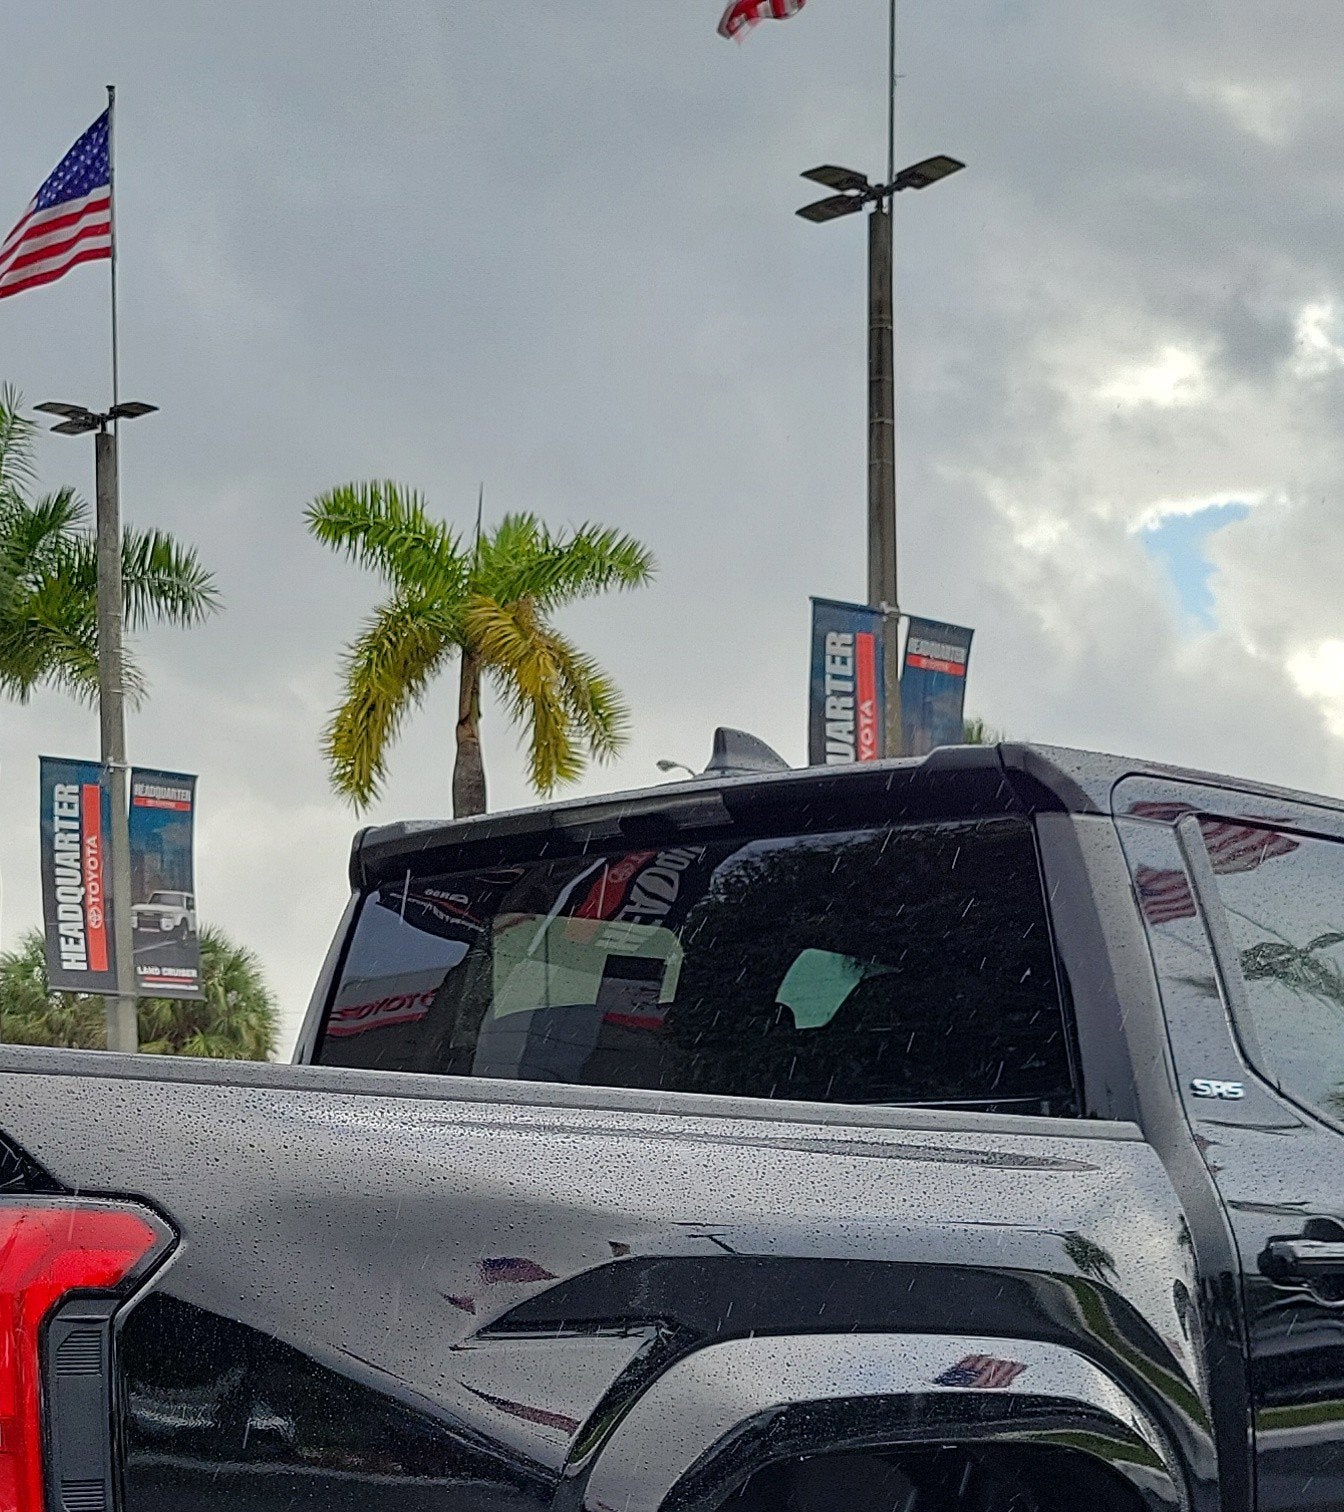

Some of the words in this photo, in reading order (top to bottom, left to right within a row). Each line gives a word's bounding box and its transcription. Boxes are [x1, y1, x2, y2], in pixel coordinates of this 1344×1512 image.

[54, 782, 88, 971] HEADQUARTER
[84, 835, 101, 903] TOYOTA
[1191, 1078, 1244, 1100] SR5
